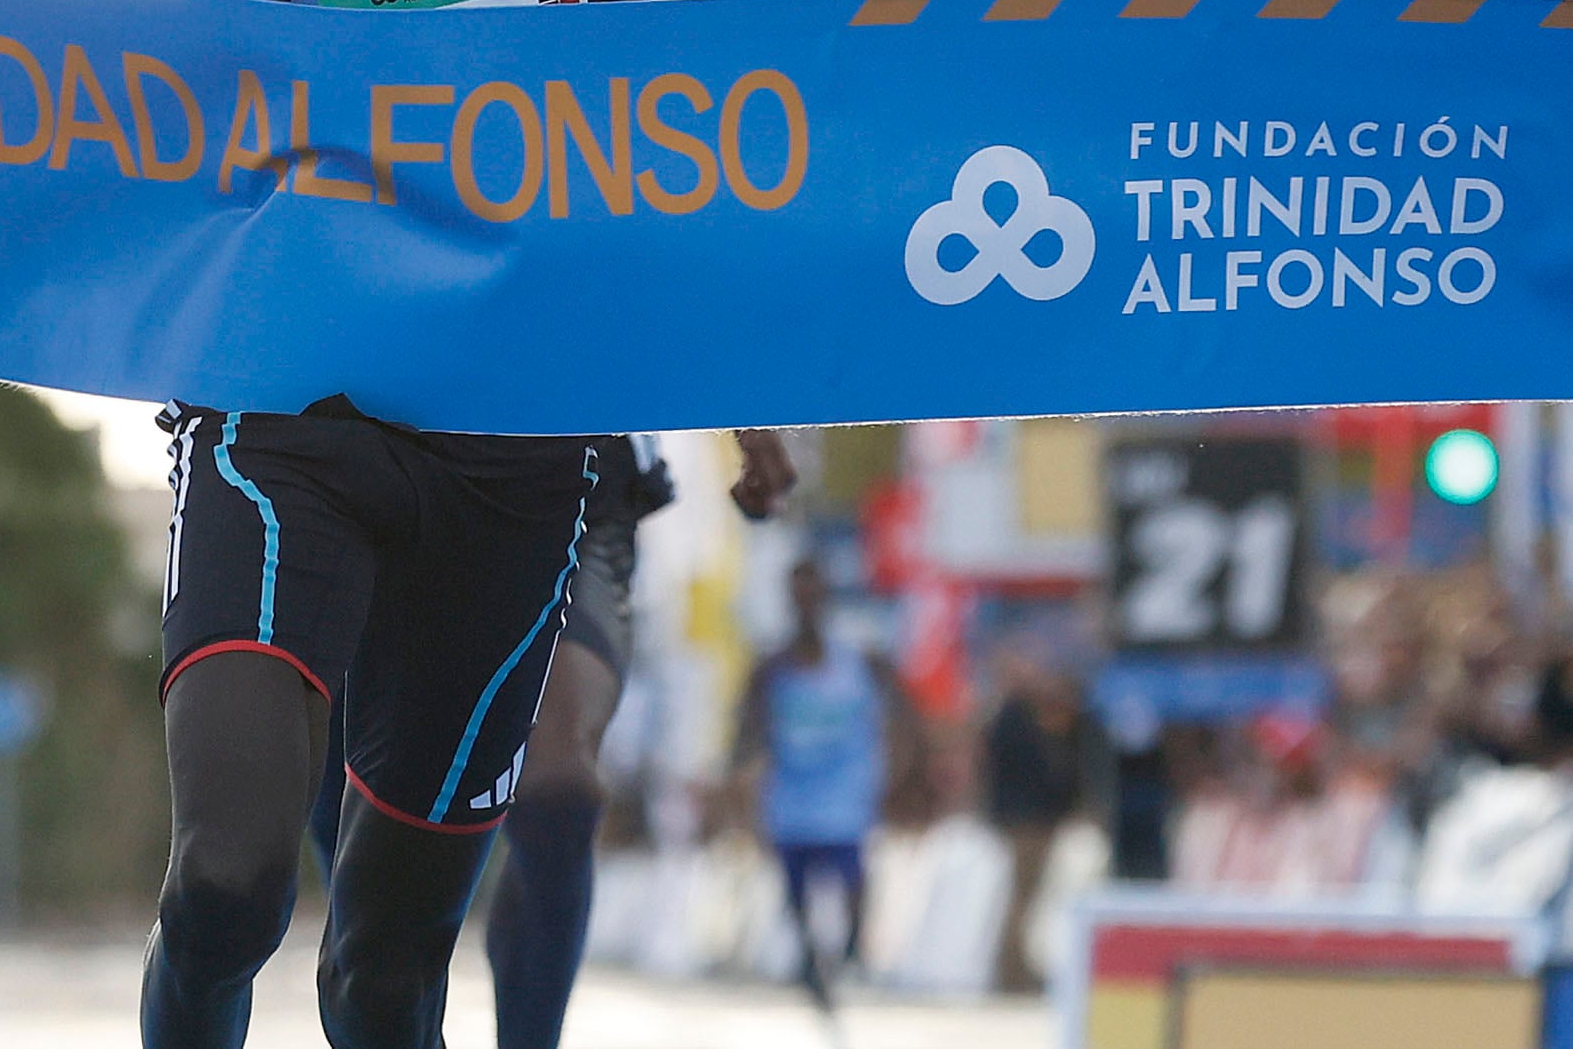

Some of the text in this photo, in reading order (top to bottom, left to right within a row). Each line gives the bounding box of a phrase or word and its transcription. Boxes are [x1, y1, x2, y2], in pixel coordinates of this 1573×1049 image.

[218, 69, 809, 223] ALFONSO
[1130, 116, 1509, 160] FUNDACIÓN
[1125, 176, 1505, 242] TRINIDAD
[1122, 247, 1497, 315] ALFONSO
